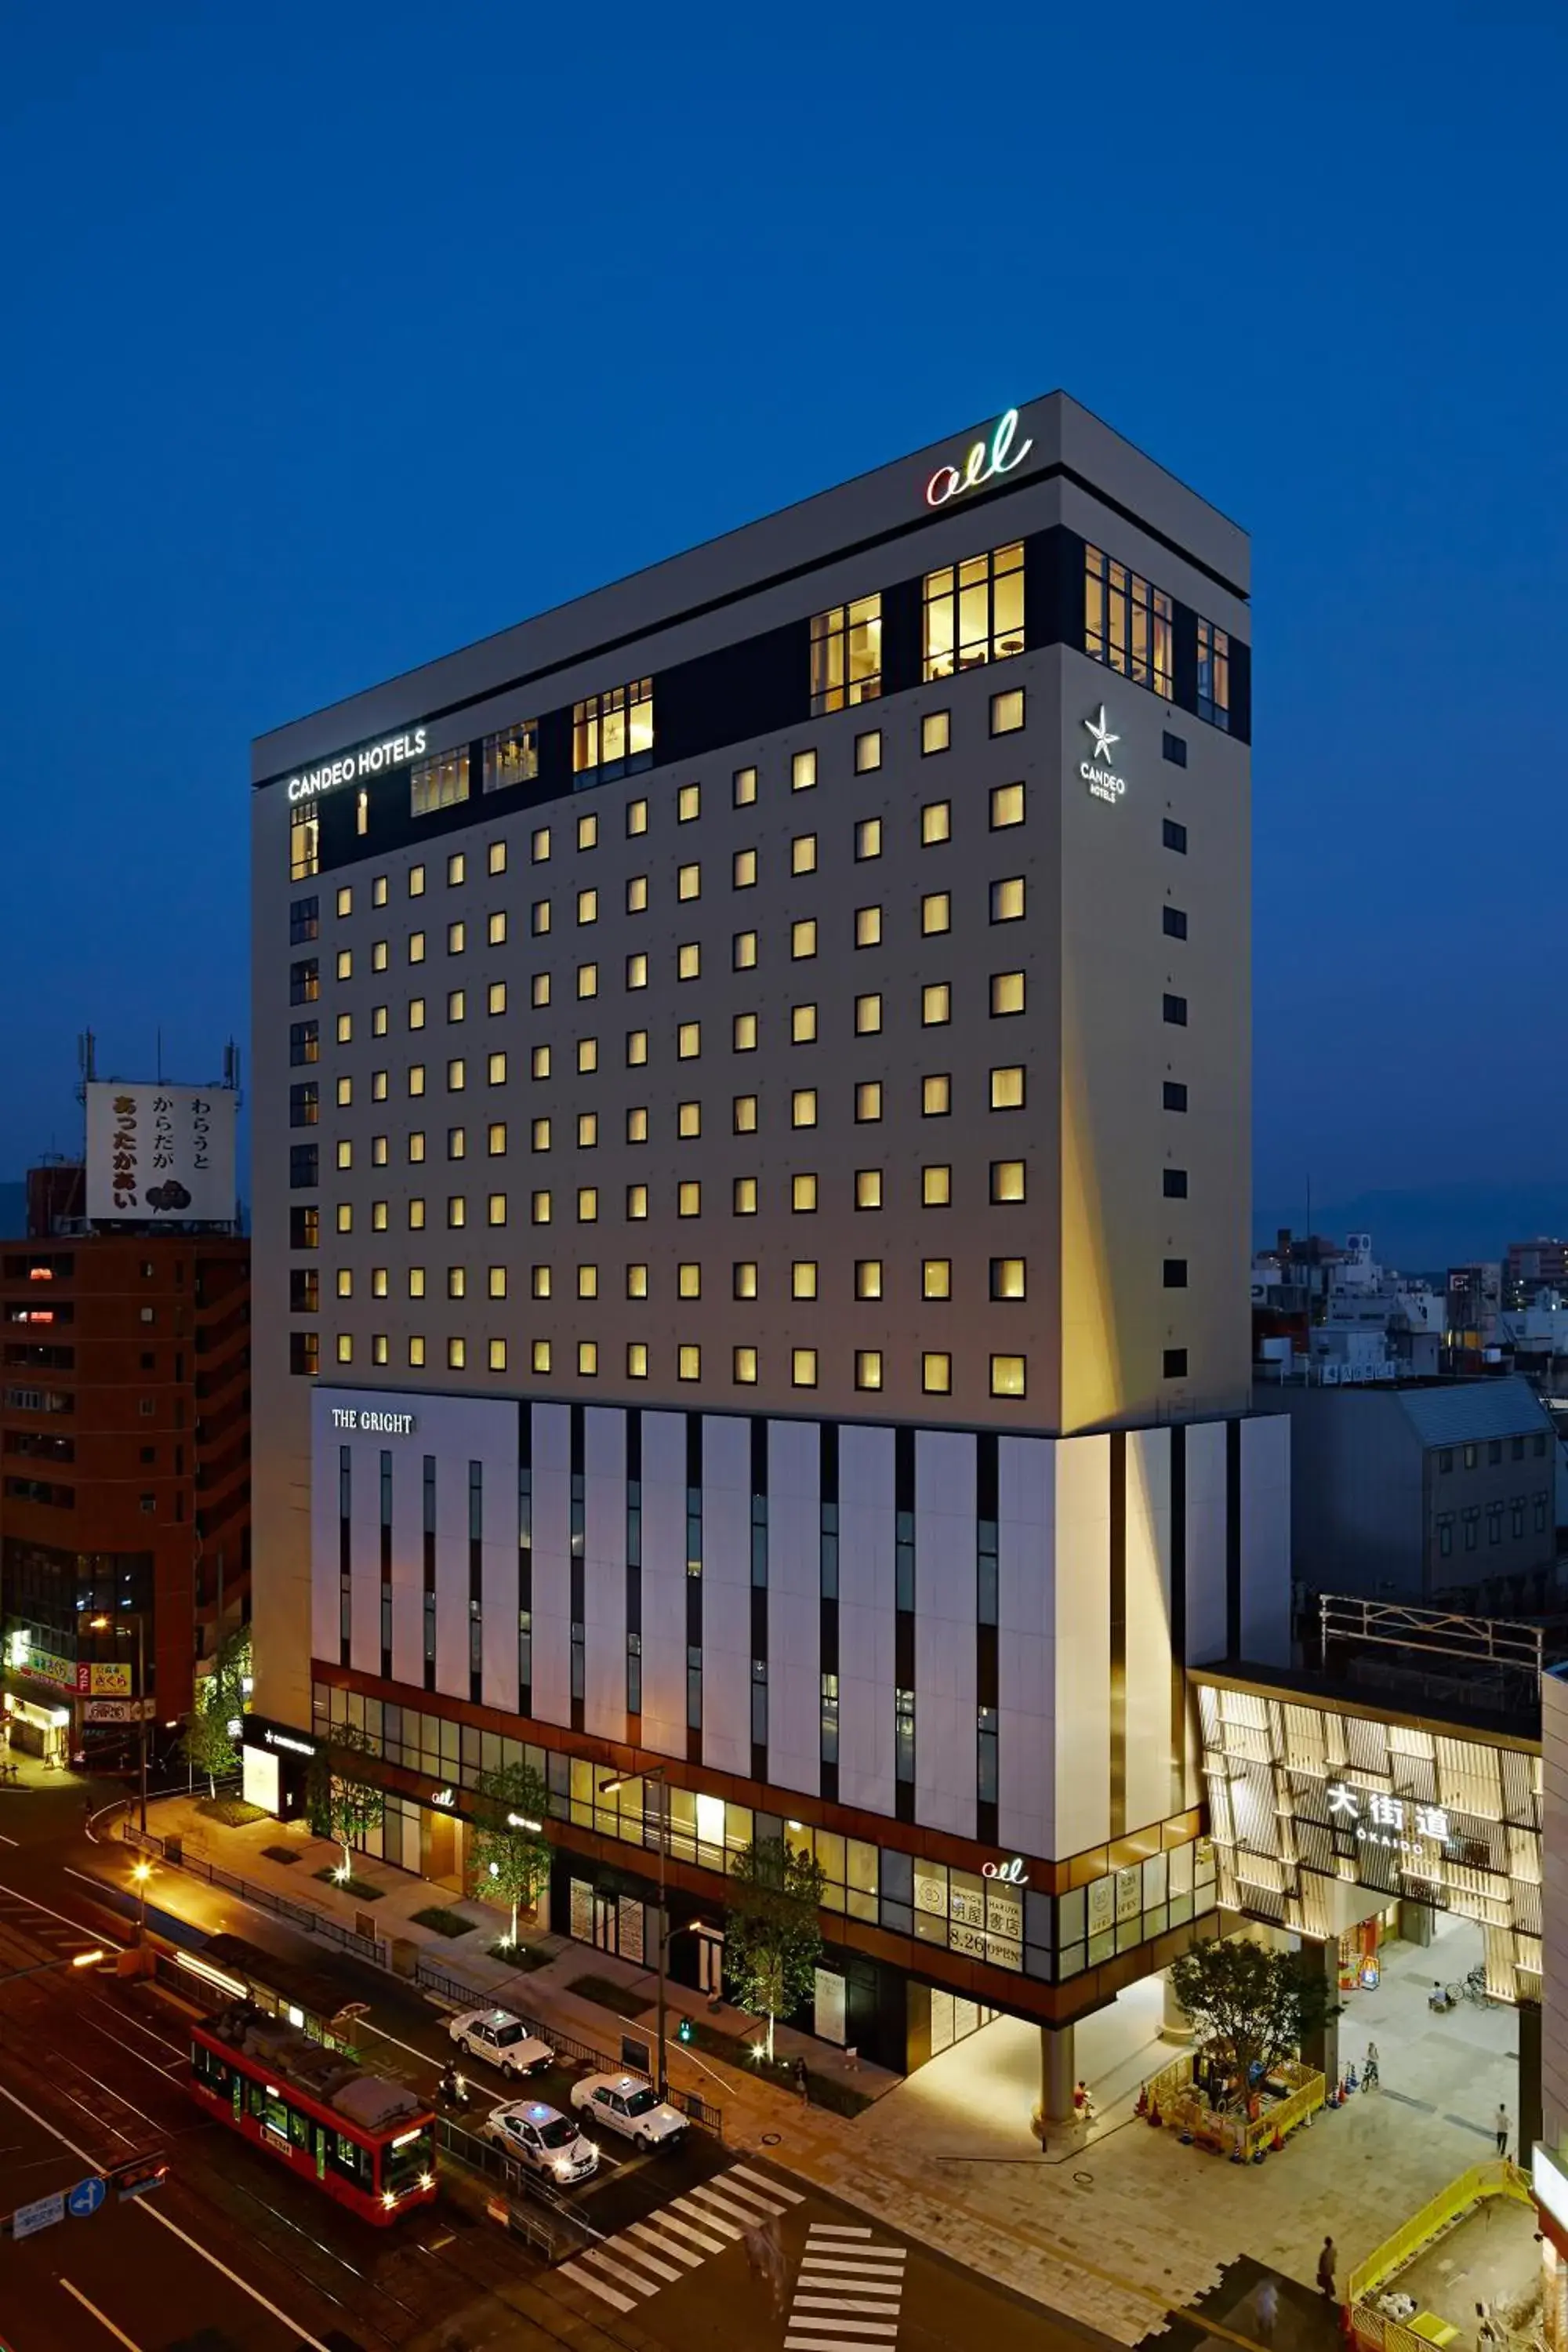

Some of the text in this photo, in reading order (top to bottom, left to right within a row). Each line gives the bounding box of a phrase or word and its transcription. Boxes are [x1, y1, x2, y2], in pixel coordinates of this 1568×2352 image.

[288, 730, 426, 800] CANDEO HOTELS
[1080, 762, 1125, 794] CANDEO
[153, 1097, 173, 1168] からだが
[191, 1098, 211, 1169] わらうと
[332, 1409, 412, 1434] THE GRIGHT
[1327, 1784, 1450, 1842] 大街道
[949, 1928, 1018, 1962] 8.26 OPEN
